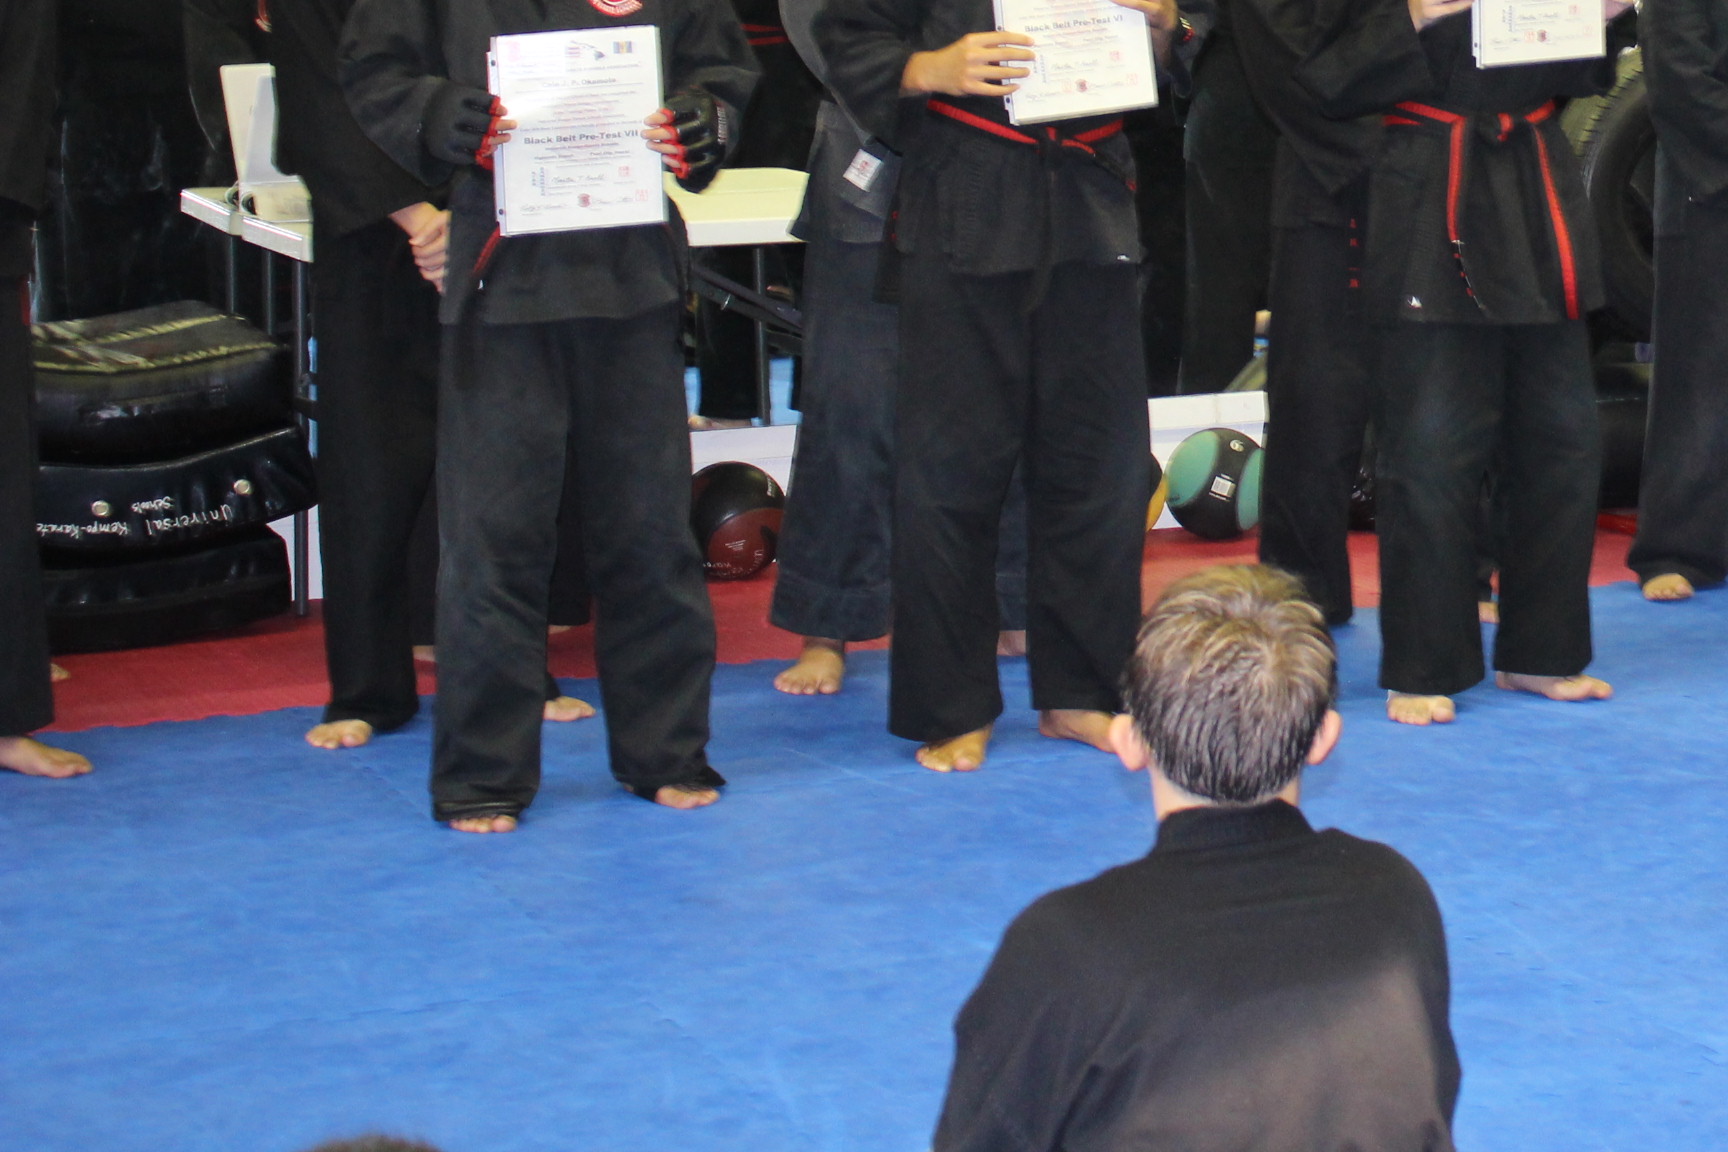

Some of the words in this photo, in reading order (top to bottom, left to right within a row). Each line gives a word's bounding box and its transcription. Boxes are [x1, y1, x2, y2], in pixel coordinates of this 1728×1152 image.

[524, 136, 553, 145] Black
[555, 134, 576, 144] Belt
[579, 131, 622, 141] Pre-Test
[144, 503, 234, 537] Universal
